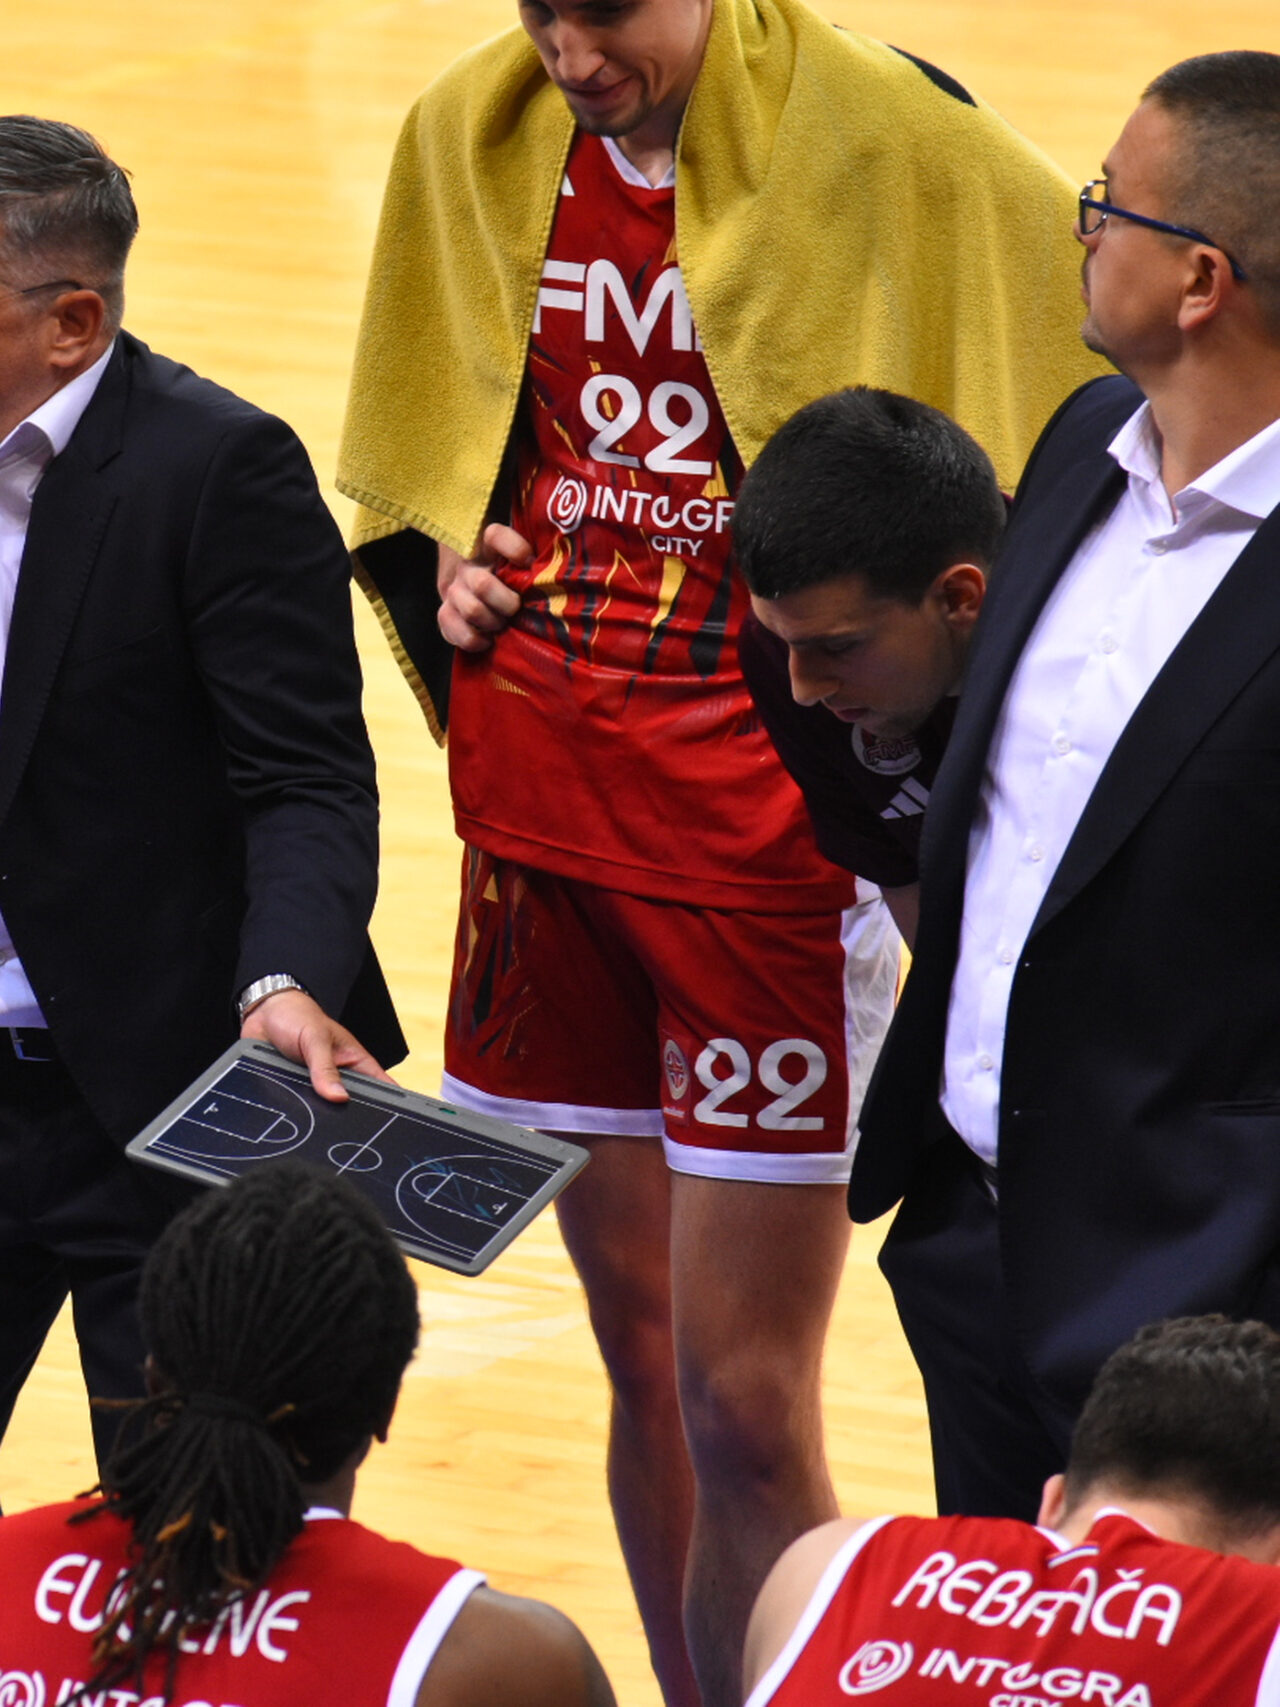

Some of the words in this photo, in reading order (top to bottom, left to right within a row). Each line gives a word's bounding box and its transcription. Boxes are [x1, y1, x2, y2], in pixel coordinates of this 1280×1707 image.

[531, 259, 705, 358] FM
[580, 374, 712, 476] 22
[651, 535, 704, 557] CITY
[693, 1038, 827, 1131] 22
